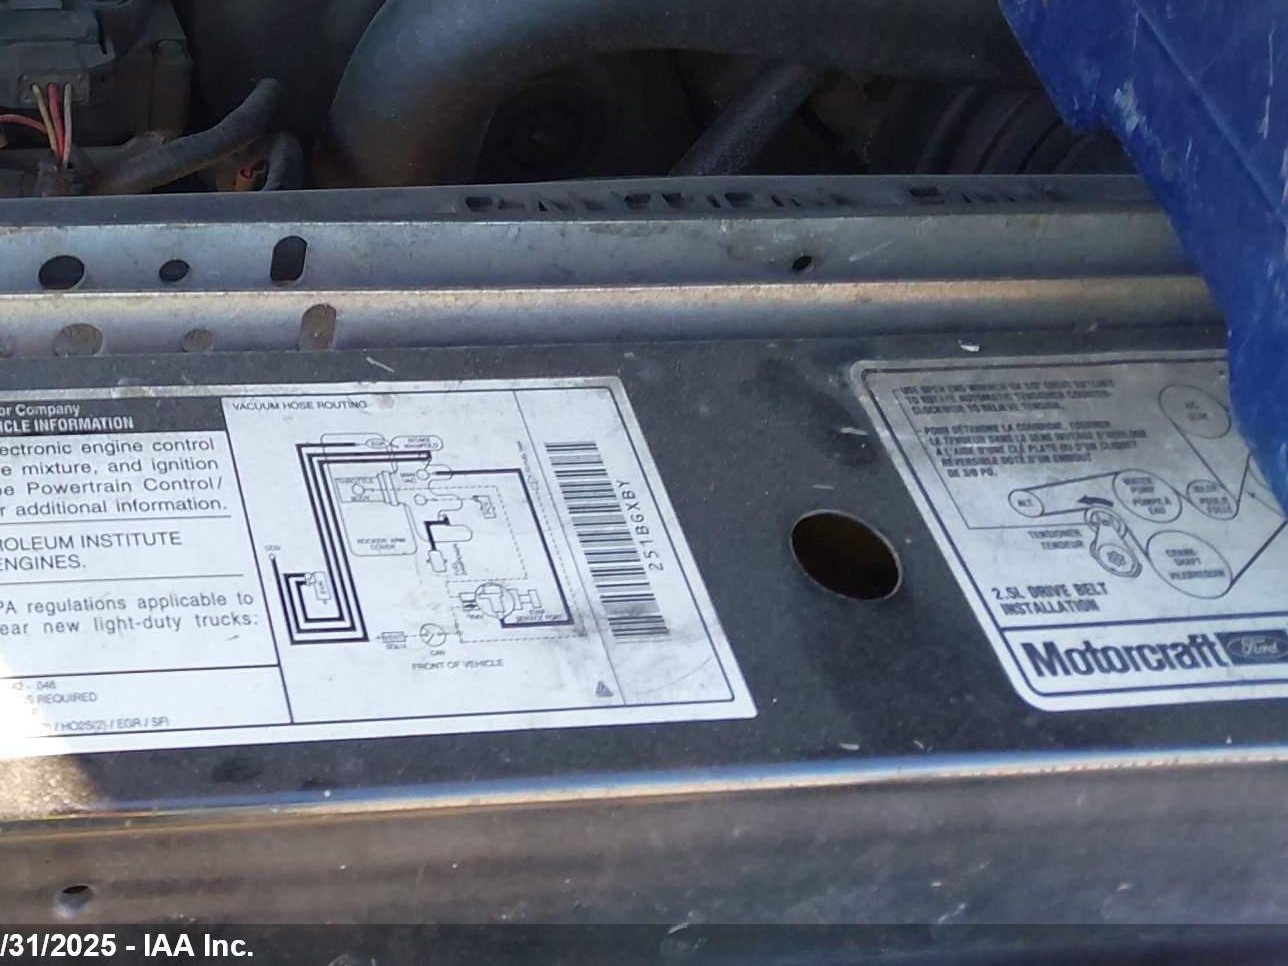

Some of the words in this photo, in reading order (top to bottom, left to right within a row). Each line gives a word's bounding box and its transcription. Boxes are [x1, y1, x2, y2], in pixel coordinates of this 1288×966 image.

[14, 403, 80, 417] Company
[231, 400, 280, 411] VACUUM
[282, 400, 314, 411] HOSE
[316, 399, 368, 410] ROUTING
[33, 416, 135, 432] INFORMATION
[81, 439, 143, 456] engine
[152, 437, 215, 452] control
[22, 461, 99, 476] mixture,
[108, 458, 142, 472] and
[151, 457, 219, 474] ignition
[26, 477, 132, 496] Powertrain
[143, 476, 223, 492] Control/
[15, 500, 108, 516] additional
[116, 498, 228, 514] information.
[80, 530, 182, 549] INSTITUTE
[1028, 583, 1070, 599] DRIVE
[1075, 581, 1109, 597] BELT
[27, 596, 127, 617] regulations
[137, 593, 228, 613] applicable
[237, 592, 254, 606] to
[1000, 598, 1101, 616] INSTALLATION
[43, 620, 80, 635] new
[94, 614, 182, 635] light-duty
[1020, 633, 1234, 677] Motorcraft
[1240, 637, 1280, 655] Ford
[412, 662, 445, 671] FRONT
[447, 661, 459, 669] OF
[461, 659, 504, 668] VEHICLE
[37, 692, 98, 705] REQUIRED
[117, 717, 141, 729] EGR
